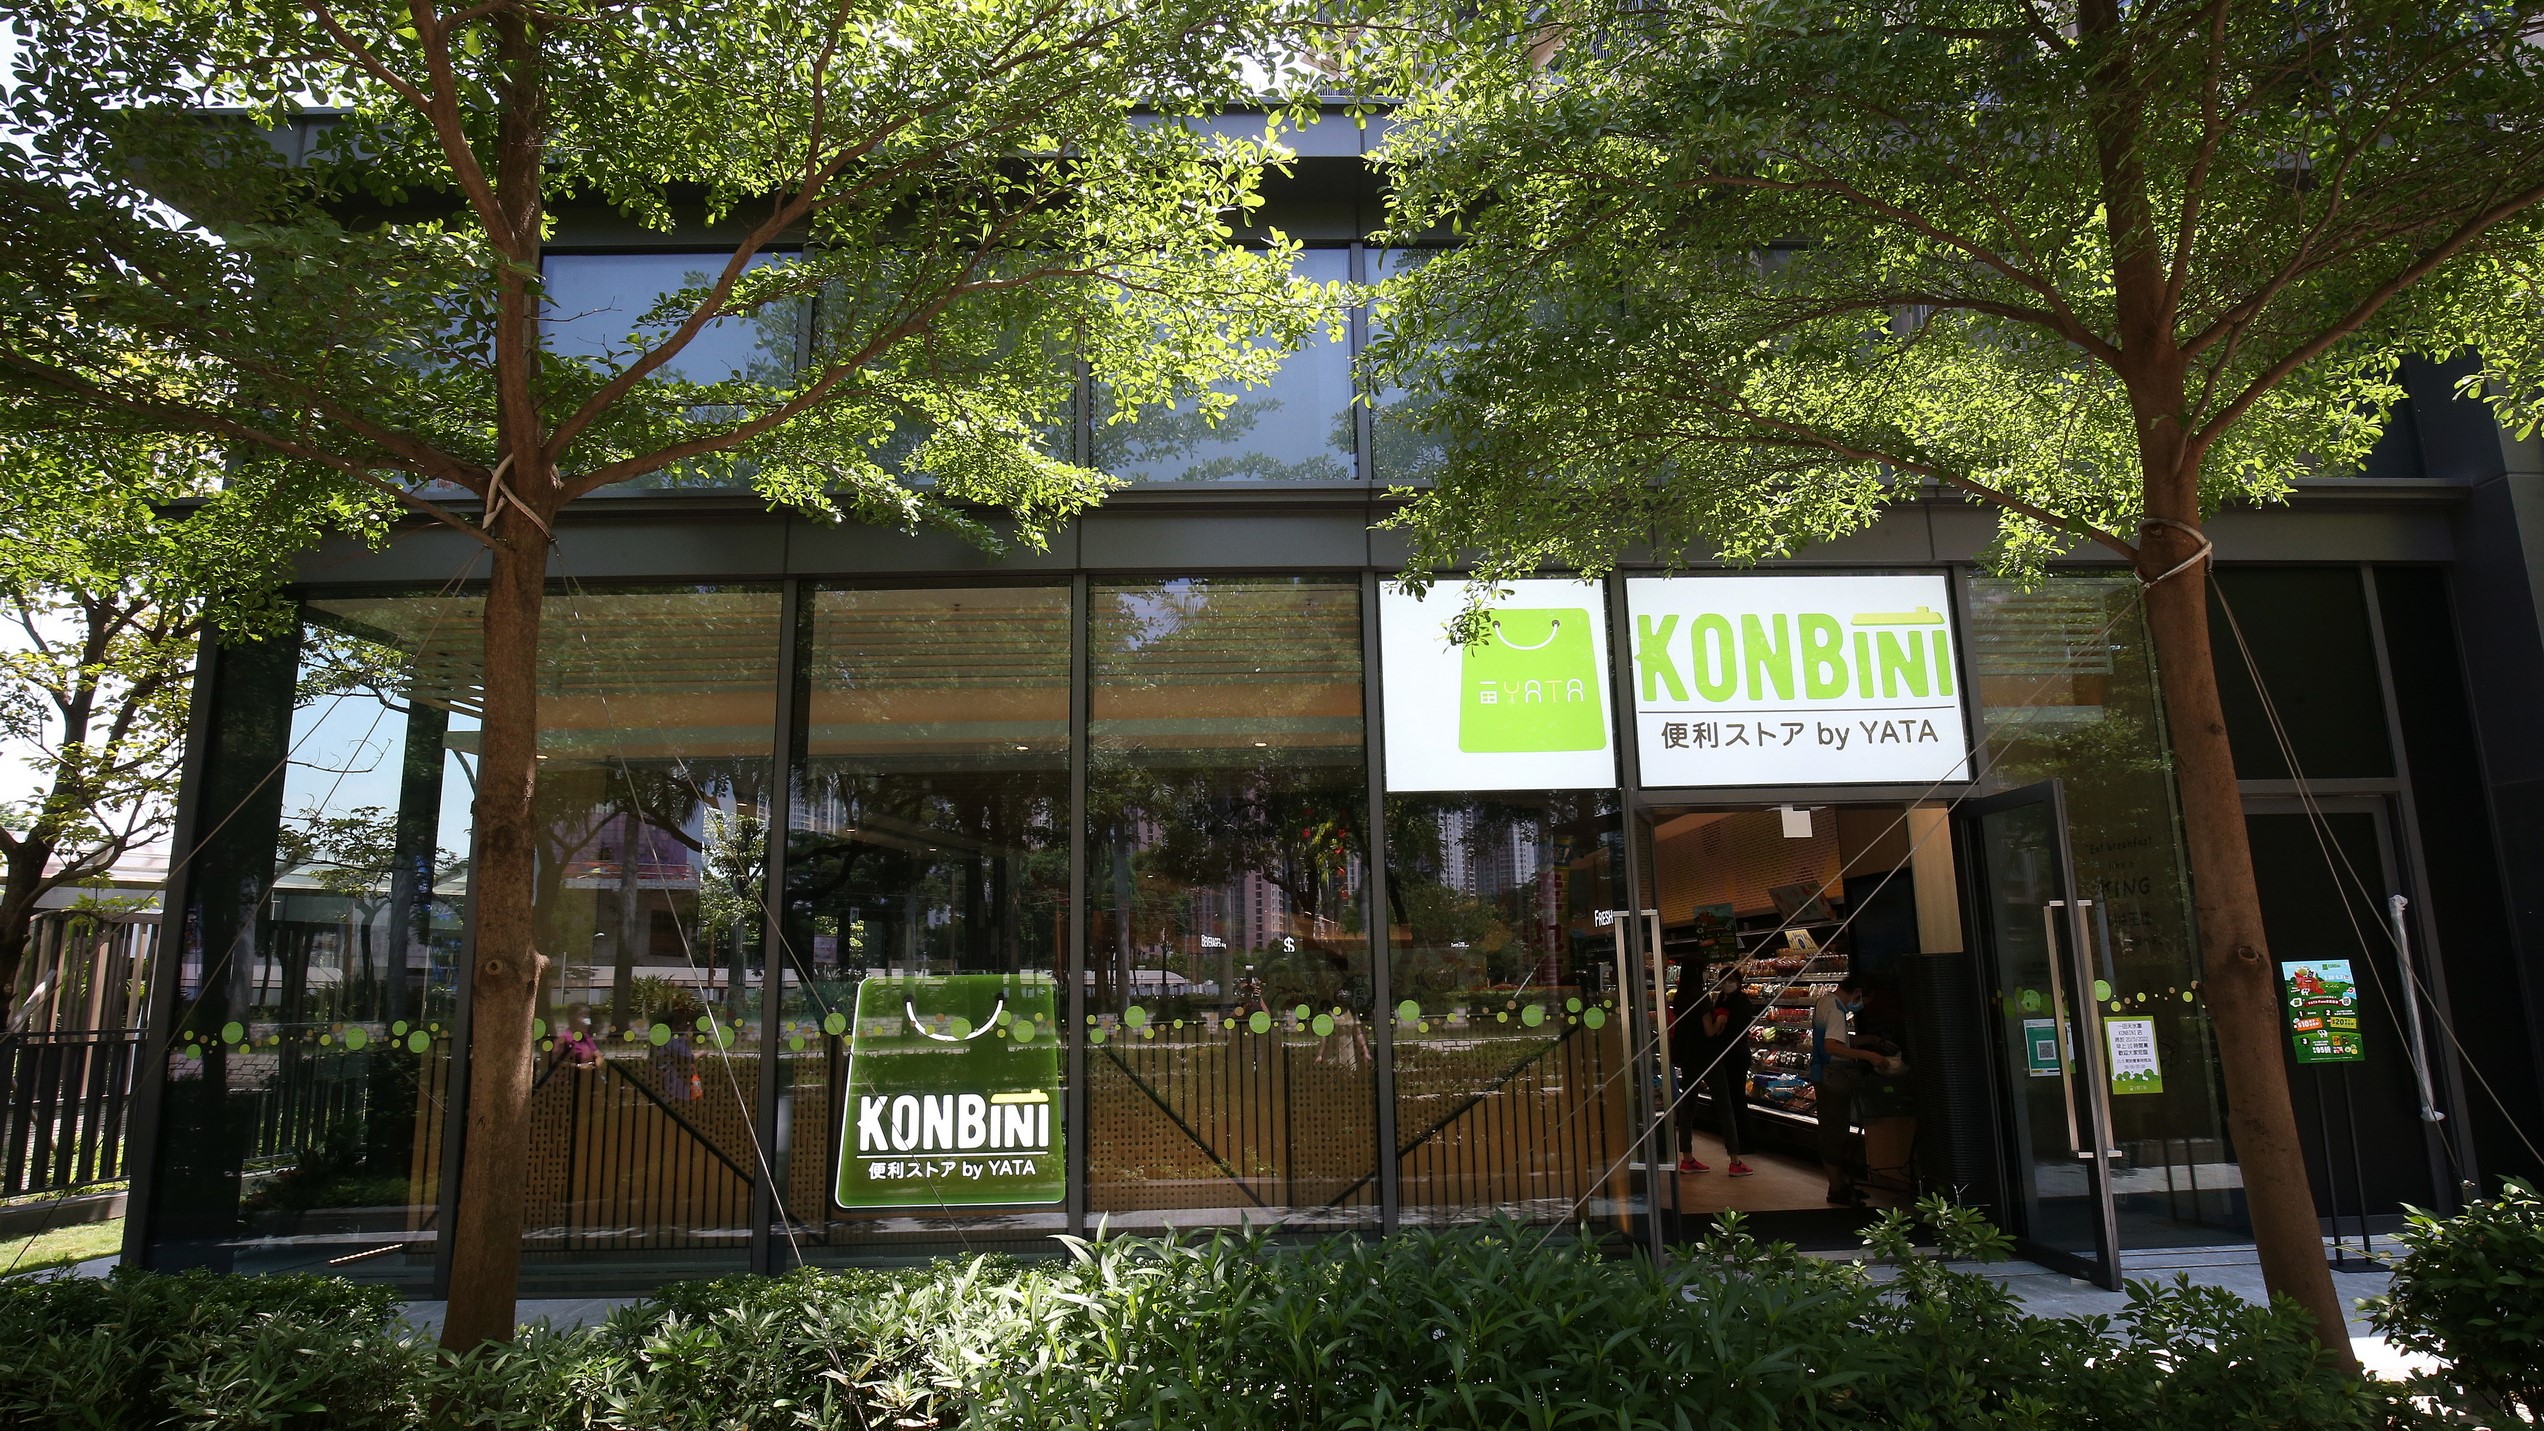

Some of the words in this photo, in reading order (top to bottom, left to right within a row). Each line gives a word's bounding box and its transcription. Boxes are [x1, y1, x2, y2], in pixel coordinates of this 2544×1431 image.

[1634, 608, 1954, 702] KONBINI
[1503, 678, 1585, 705] YATA
[1660, 720, 1806, 750] 便利ストア
[1817, 721, 1850, 751] by
[1859, 718, 1940, 745] YATA
[2101, 876, 2150, 899] KING
[856, 1091, 1050, 1152] KONBINI
[868, 1160, 957, 1181] 便利ストア
[962, 1162, 984, 1181] by
[988, 1159, 1037, 1177] YATA
